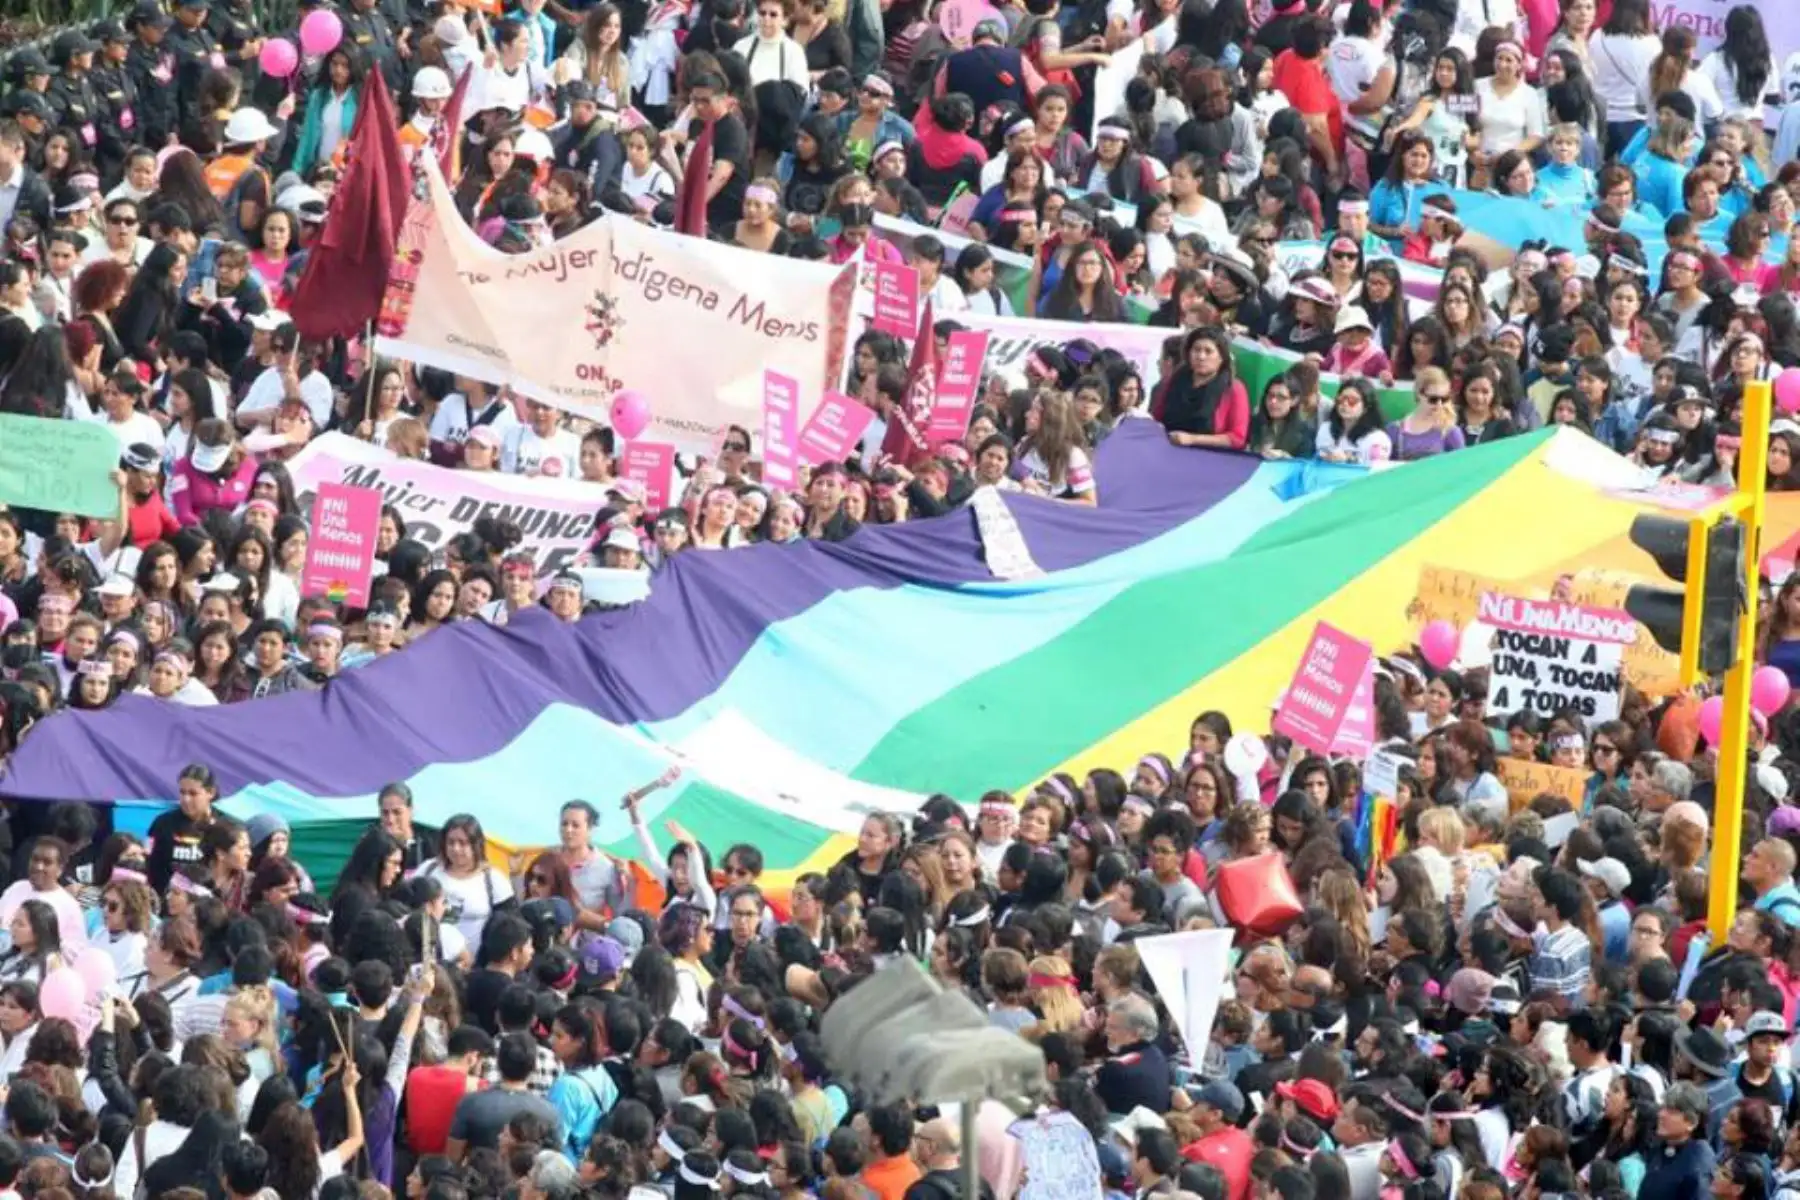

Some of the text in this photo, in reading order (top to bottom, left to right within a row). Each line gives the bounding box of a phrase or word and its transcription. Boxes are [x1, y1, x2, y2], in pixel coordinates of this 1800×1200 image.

[1496, 628, 1598, 666] TOCAN A
[1548, 663, 1620, 694] TOCAN
[1491, 685, 1597, 717] A TODAS
